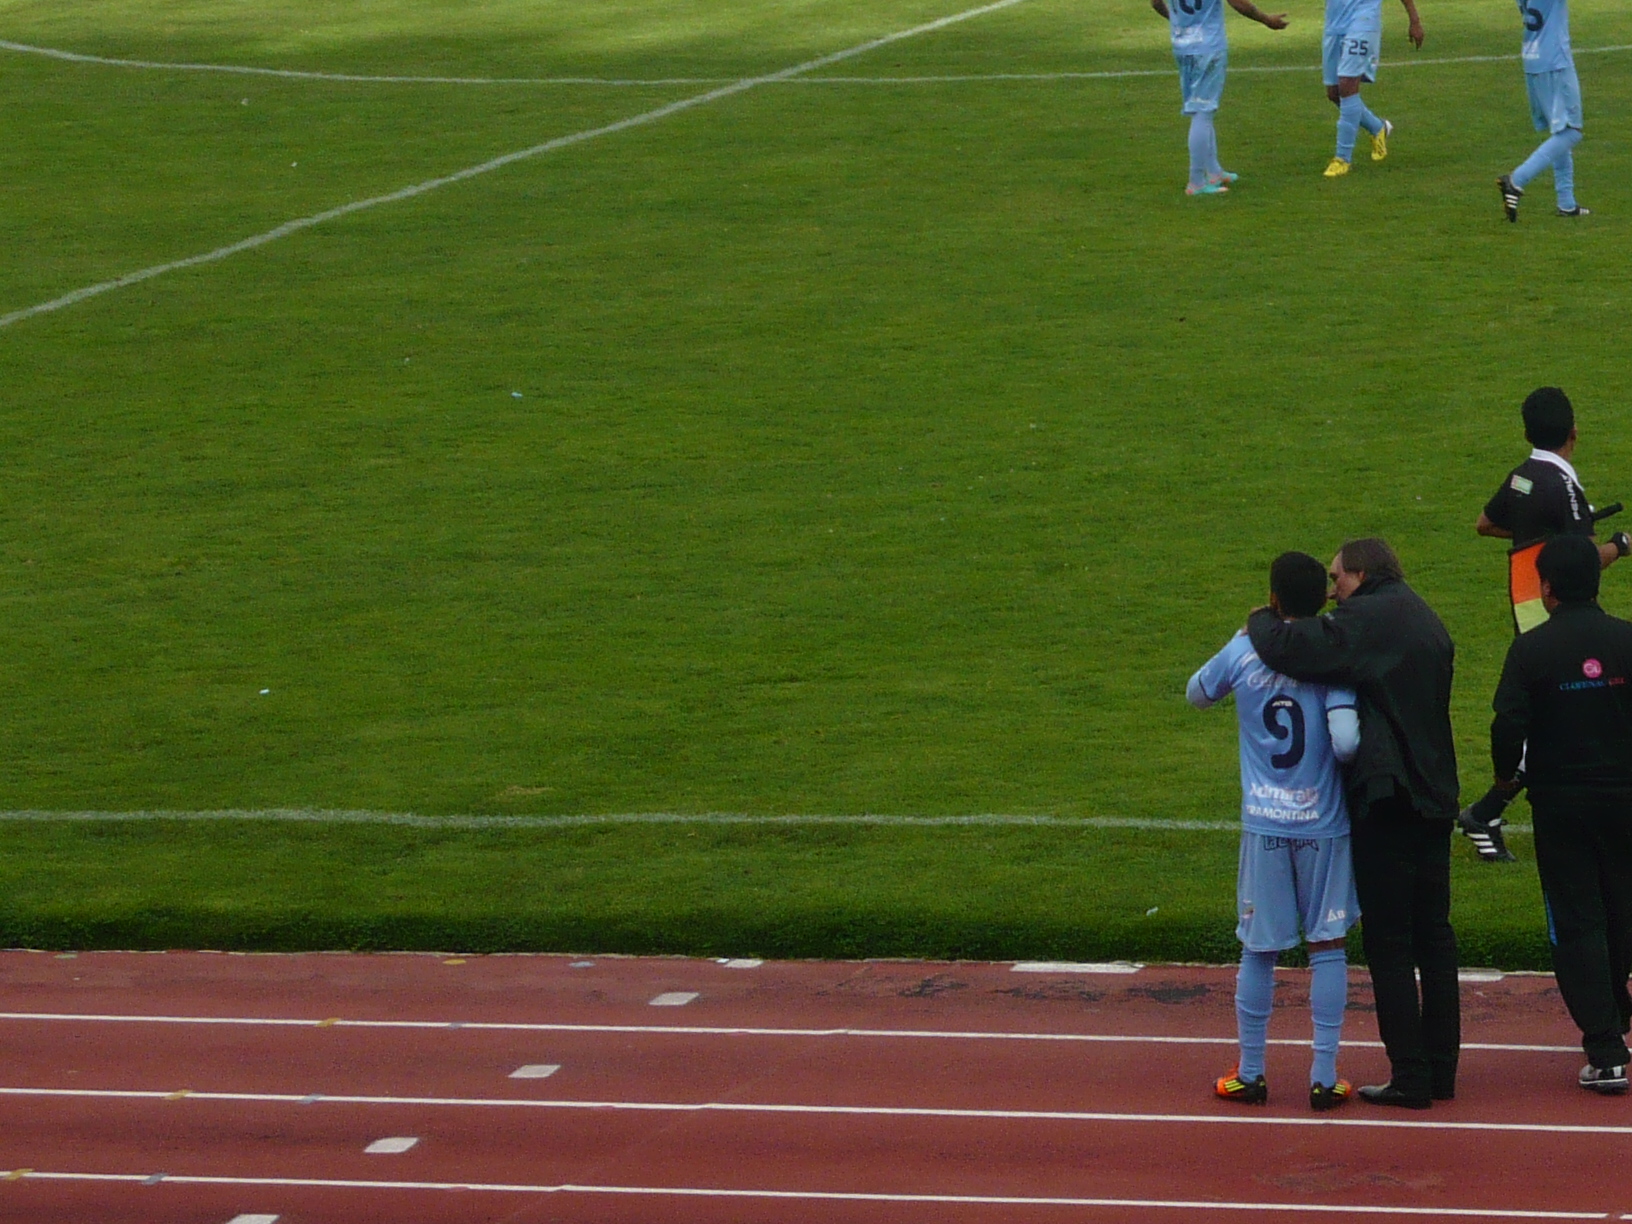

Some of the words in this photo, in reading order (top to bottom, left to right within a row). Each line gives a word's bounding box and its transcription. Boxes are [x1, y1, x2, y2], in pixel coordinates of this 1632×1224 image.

[1347, 39, 1369, 56] 25
[1262, 693, 1306, 770] 9
[1245, 803, 1320, 821] TRAMONTINA
